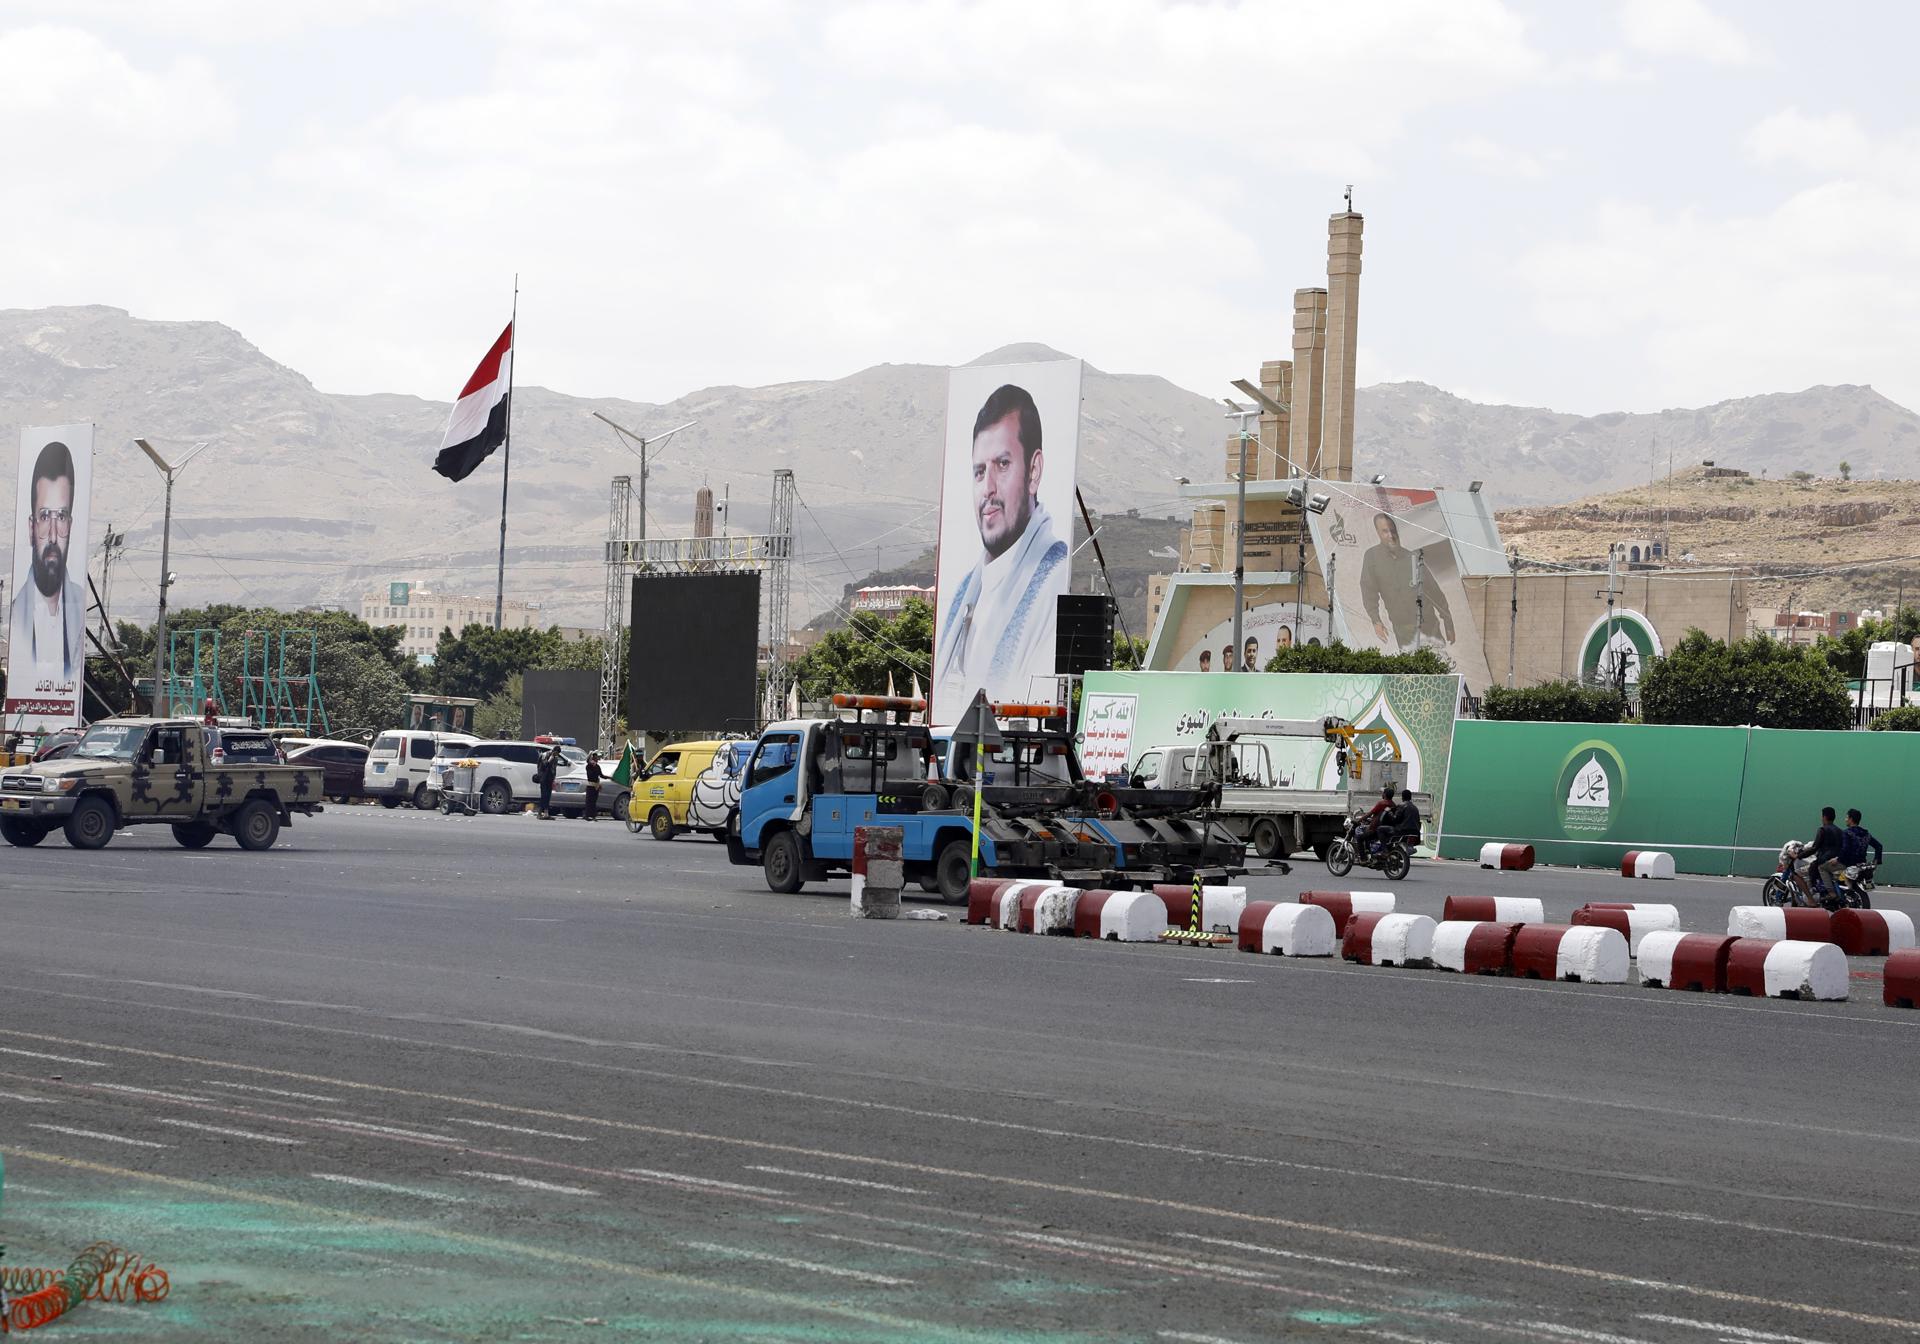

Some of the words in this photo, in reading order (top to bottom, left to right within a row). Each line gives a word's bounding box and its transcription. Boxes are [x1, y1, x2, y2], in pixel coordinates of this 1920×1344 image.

[55, 679, 76, 696] الشهيد
[1089, 699, 1116, 724] أكبر
[1115, 702, 1133, 719] الله
[1176, 709, 1210, 736] النبوي
[1110, 728, 1131, 741] الموت
[1108, 746, 1128, 760] الموت
